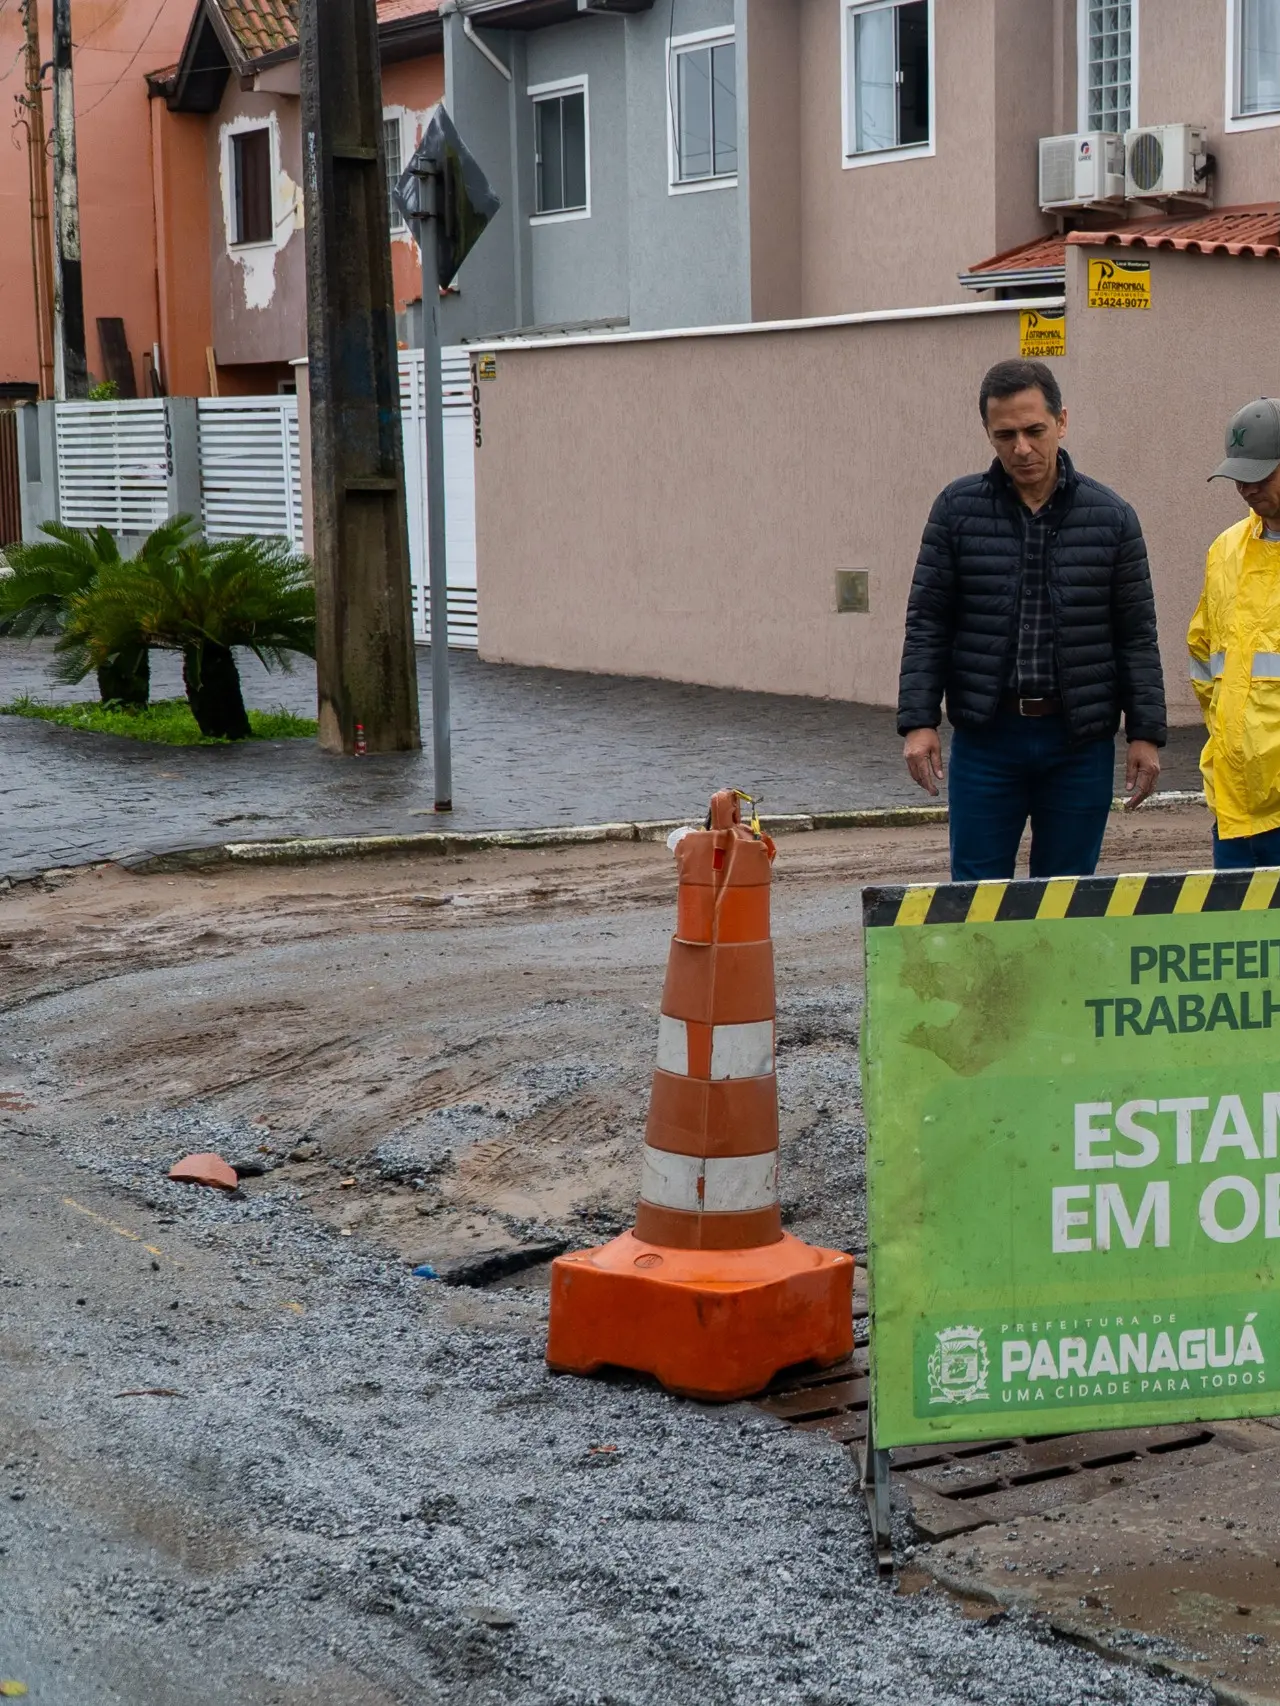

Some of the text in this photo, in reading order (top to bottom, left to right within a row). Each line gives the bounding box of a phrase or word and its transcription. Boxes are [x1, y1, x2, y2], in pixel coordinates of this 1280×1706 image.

[1098, 297, 1149, 307] 3424-9077
[1027, 346, 1063, 355] 3424-9077
[471, 363, 482, 448] 1095
[164, 406, 173, 477] 1089
[1052, 1181, 1170, 1253] EM
[1001, 1313, 1177, 1334] PREFEITURA DE
[1002, 1312, 1265, 1382] PARANAGUÁ
[1002, 1371, 1266, 1403] UMA CIDADE PARA TODOS
